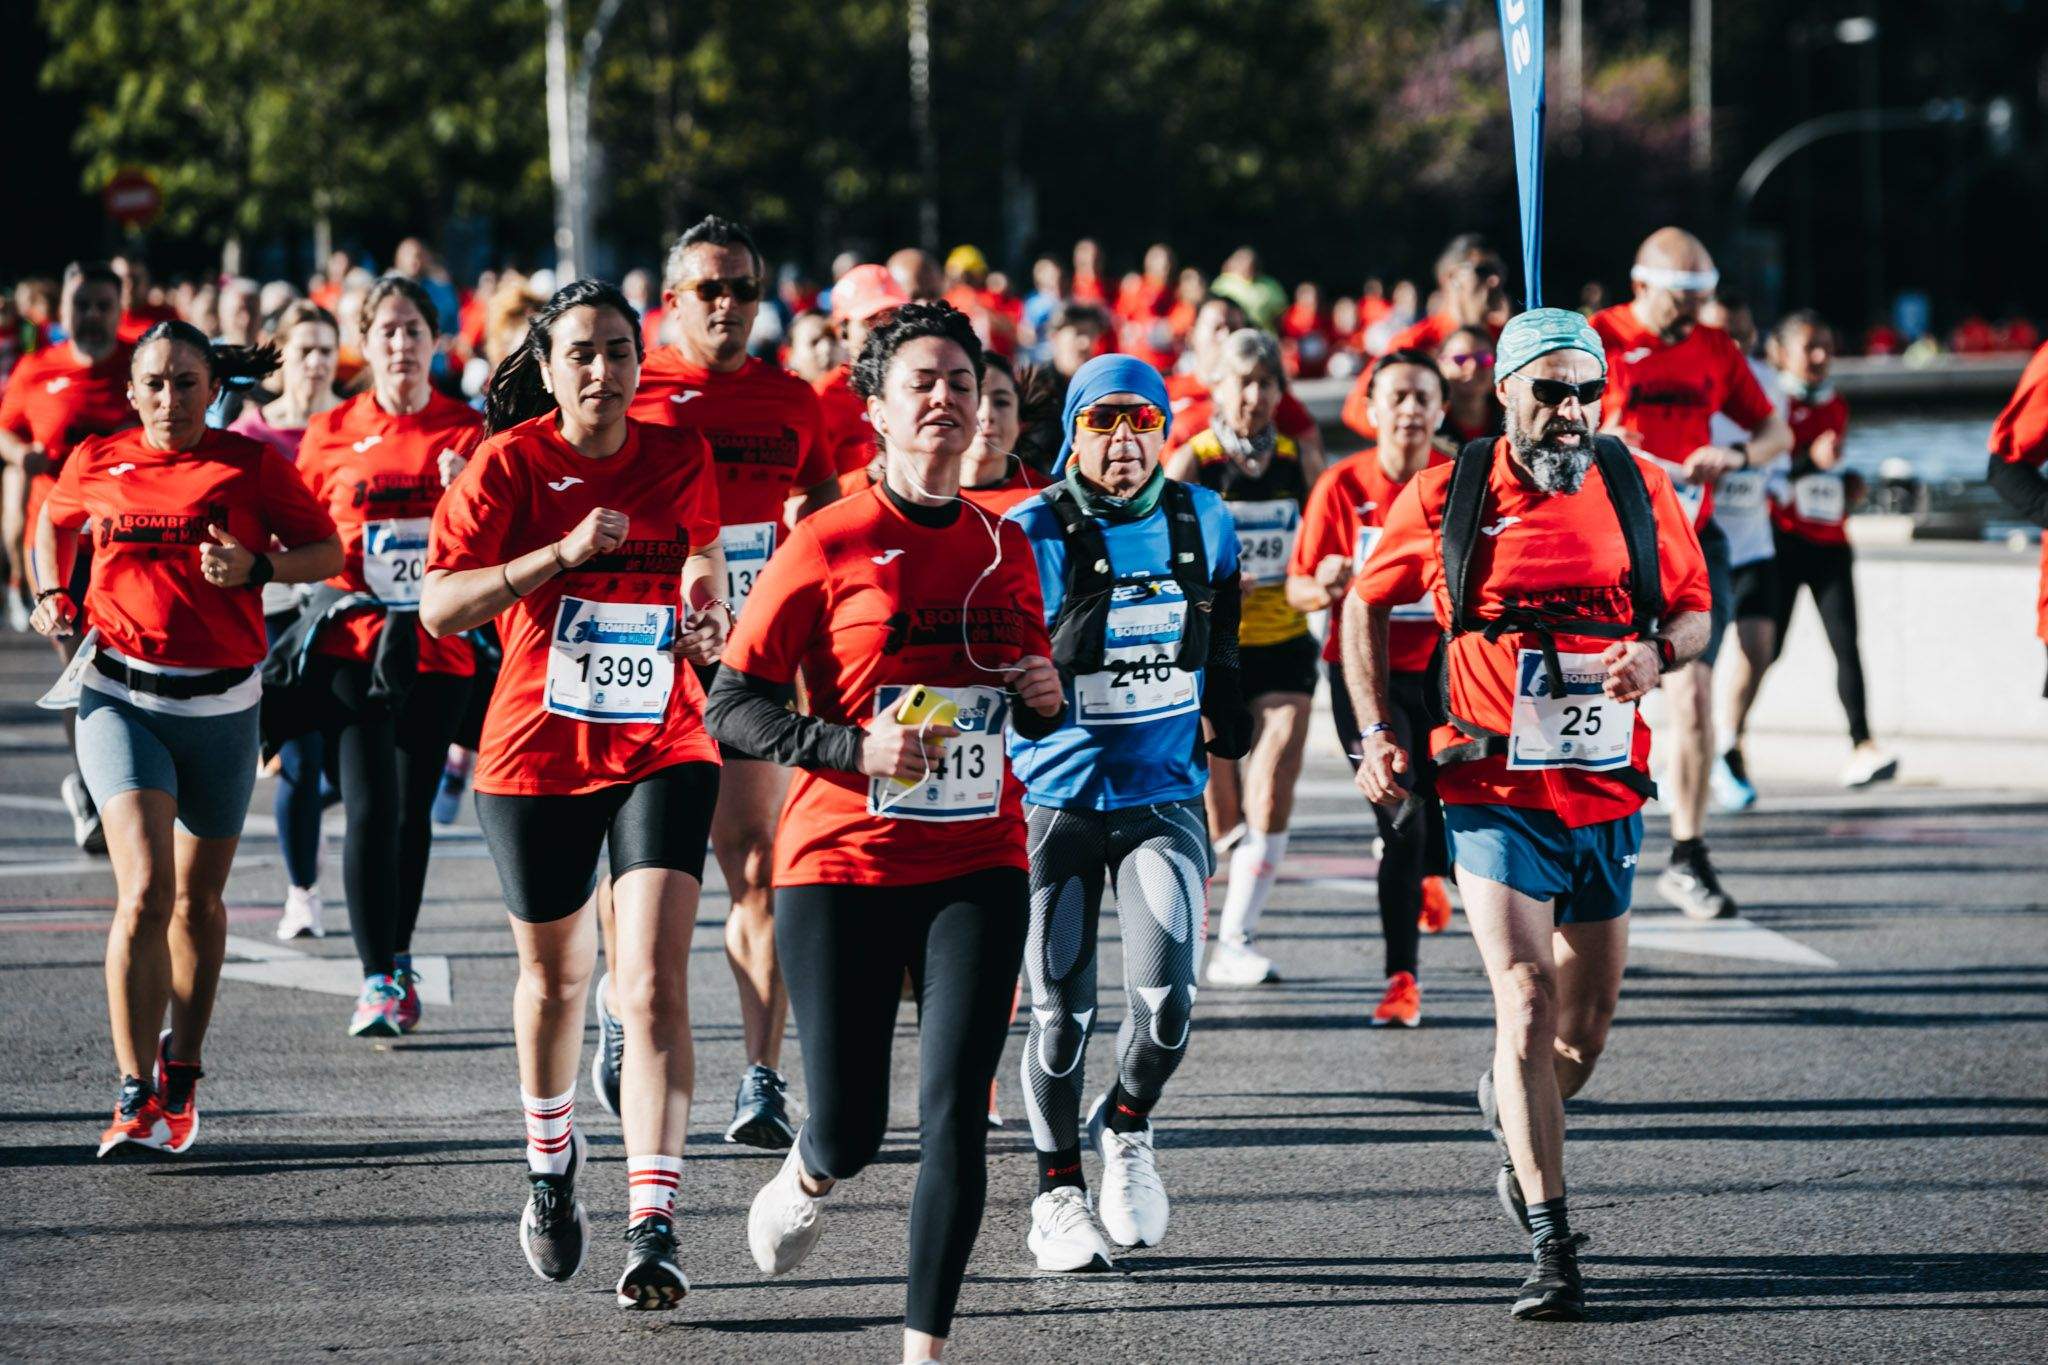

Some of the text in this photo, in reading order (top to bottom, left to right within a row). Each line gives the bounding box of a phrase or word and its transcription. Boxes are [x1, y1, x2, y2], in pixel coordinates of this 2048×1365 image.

[1240, 536, 1284, 561] 249
[597, 621, 657, 634] BOMBEROS
[1114, 621, 1181, 638] BOMBEROS
[576, 652, 653, 688] 1399
[1110, 653, 1171, 688] 246
[1559, 705, 1602, 736] 25
